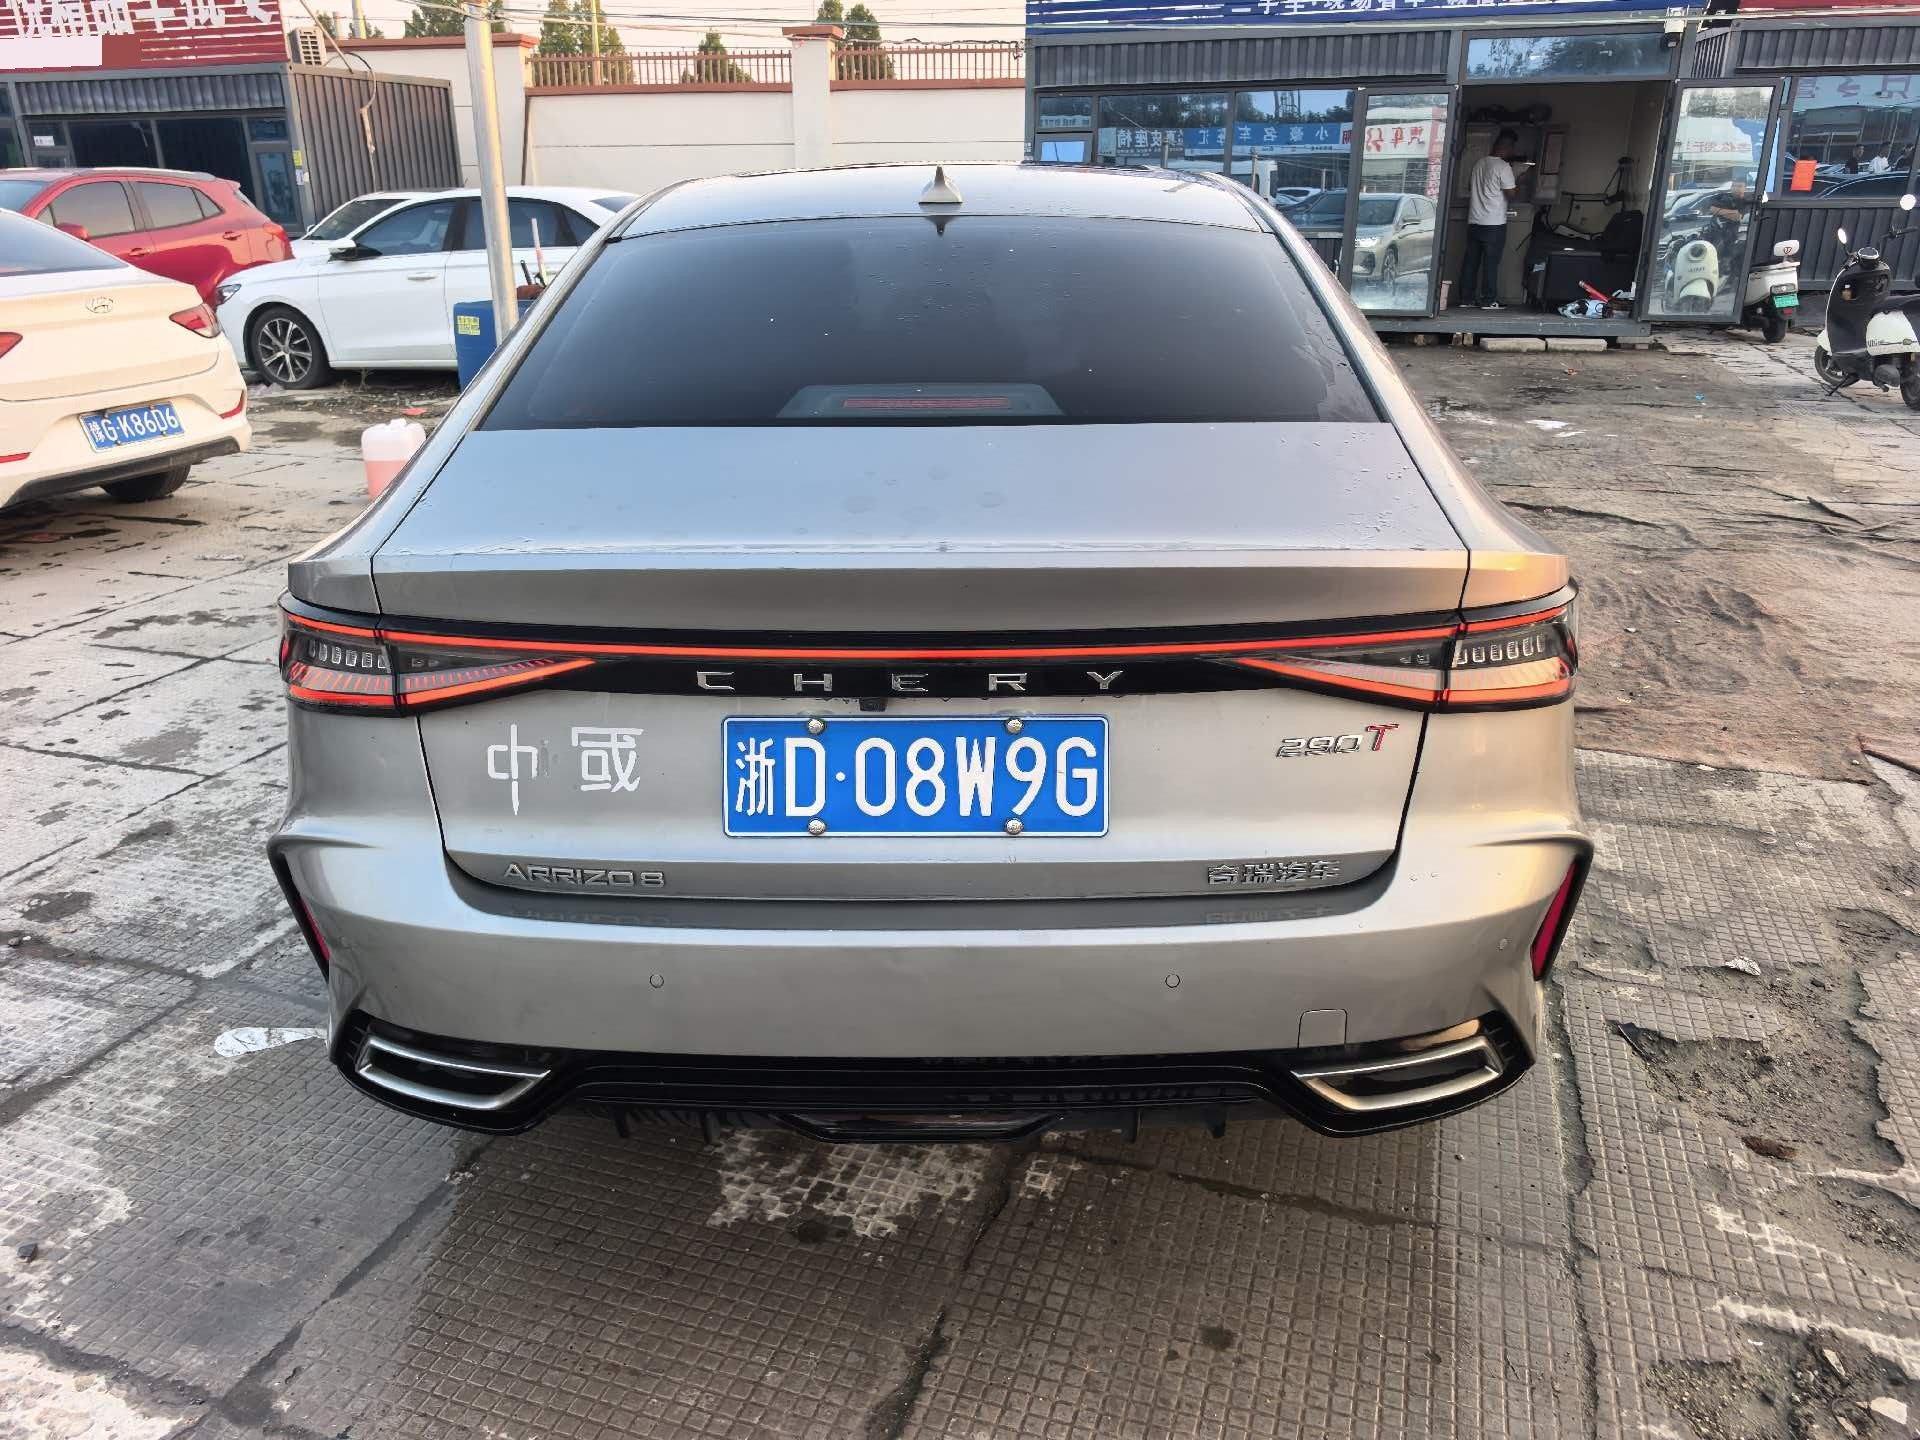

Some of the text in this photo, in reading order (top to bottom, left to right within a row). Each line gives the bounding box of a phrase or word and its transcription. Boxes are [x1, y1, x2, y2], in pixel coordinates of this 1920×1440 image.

[696, 670, 1124, 693] CHERY
[1275, 723, 1400, 758] 290T
[1207, 860, 1341, 886] 奇瑞汽车
